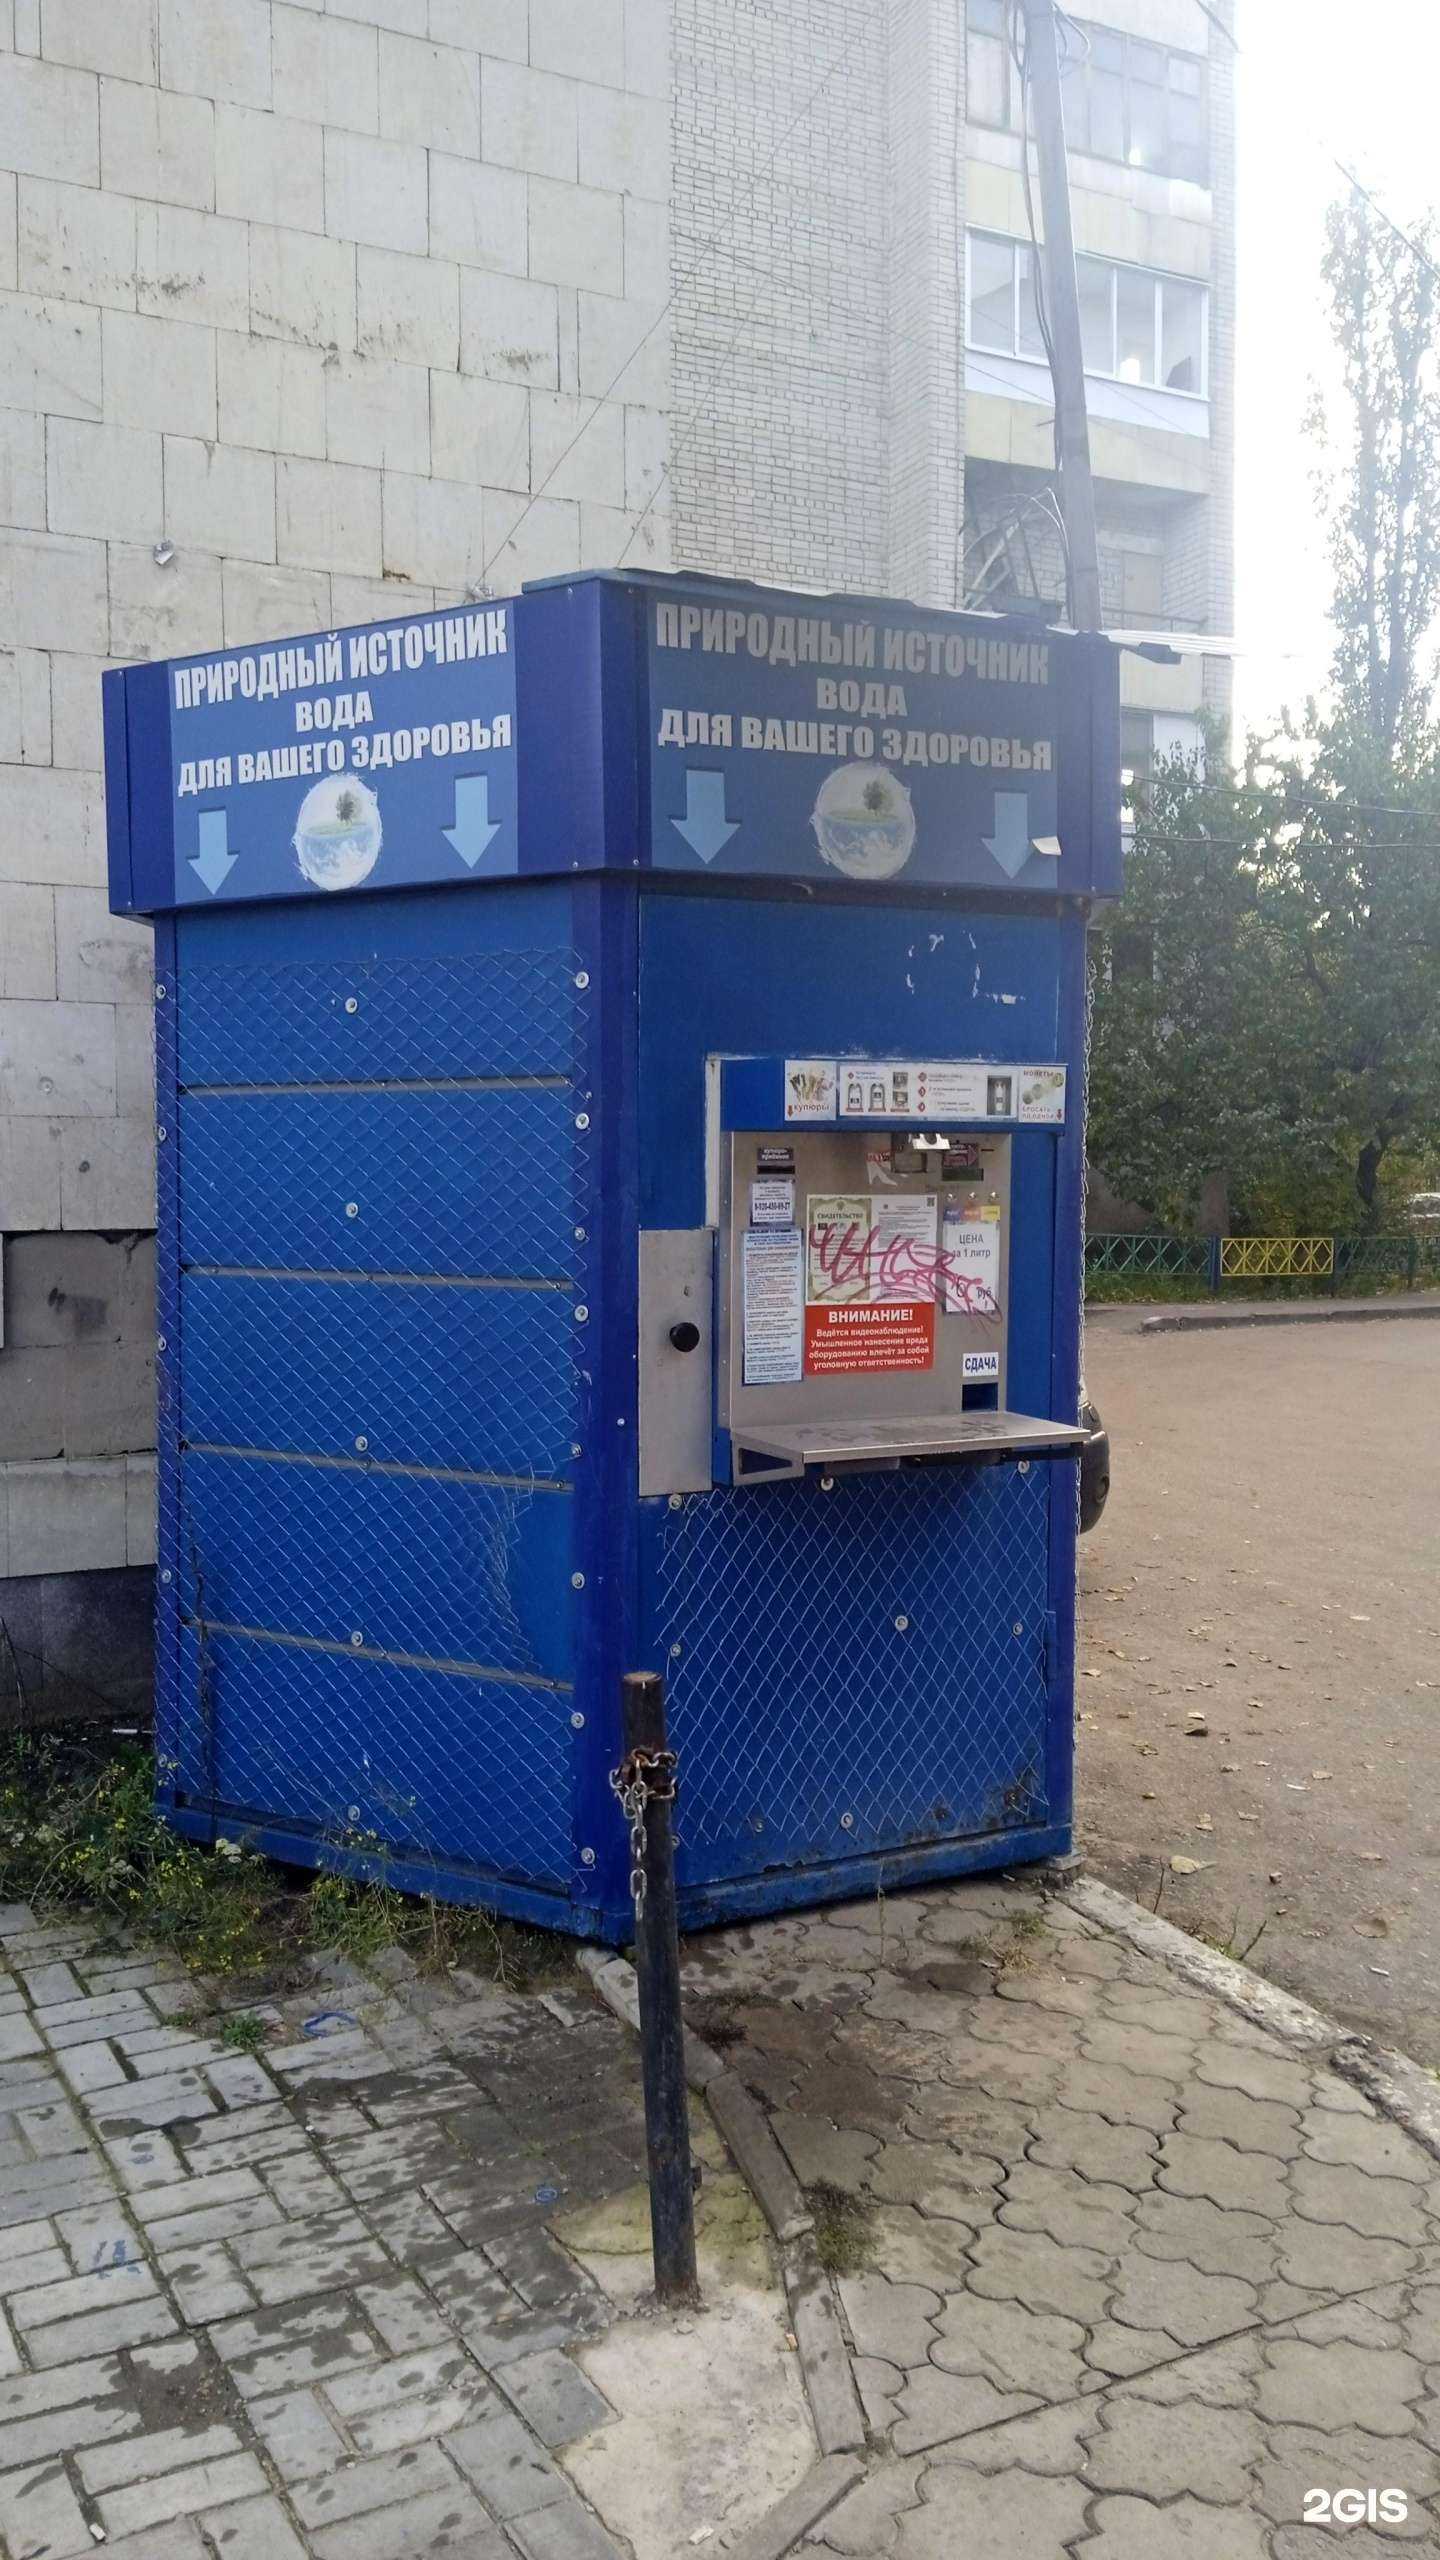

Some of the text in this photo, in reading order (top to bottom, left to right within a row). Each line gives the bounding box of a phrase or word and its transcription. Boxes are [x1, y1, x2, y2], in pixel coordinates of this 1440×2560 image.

[656, 602, 1049, 685] ПРИРОДНЫЙ ИСТОЧНИК
[174, 609, 508, 709] ПРИРОДНЫЙ ИСТОЧНИК
[816, 678, 908, 719] ВОДА
[295, 691, 374, 732] ВОДА
[657, 708, 1053, 771] ДЛЯ ВАШЕГО ЗДОРОВЬЯ
[178, 714, 512, 797] ДЛЯ ВАШЕГО ЗДОРОВЬЯ
[959, 1233, 984, 1245] ЦЕНА
[970, 1249, 991, 1258] литр
[828, 1309, 913, 1323] ВНИМАНИЕ!
[816, 1325, 924, 1338] Ведётся видеонаблюдение!
[810, 1339, 863, 1348] Умышленное
[808, 1348, 868, 1360] оборудованию
[906, 1346, 929, 1354] собой
[813, 1360, 857, 1370] уголовную
[965, 1356, 997, 1373] СДАЧА
